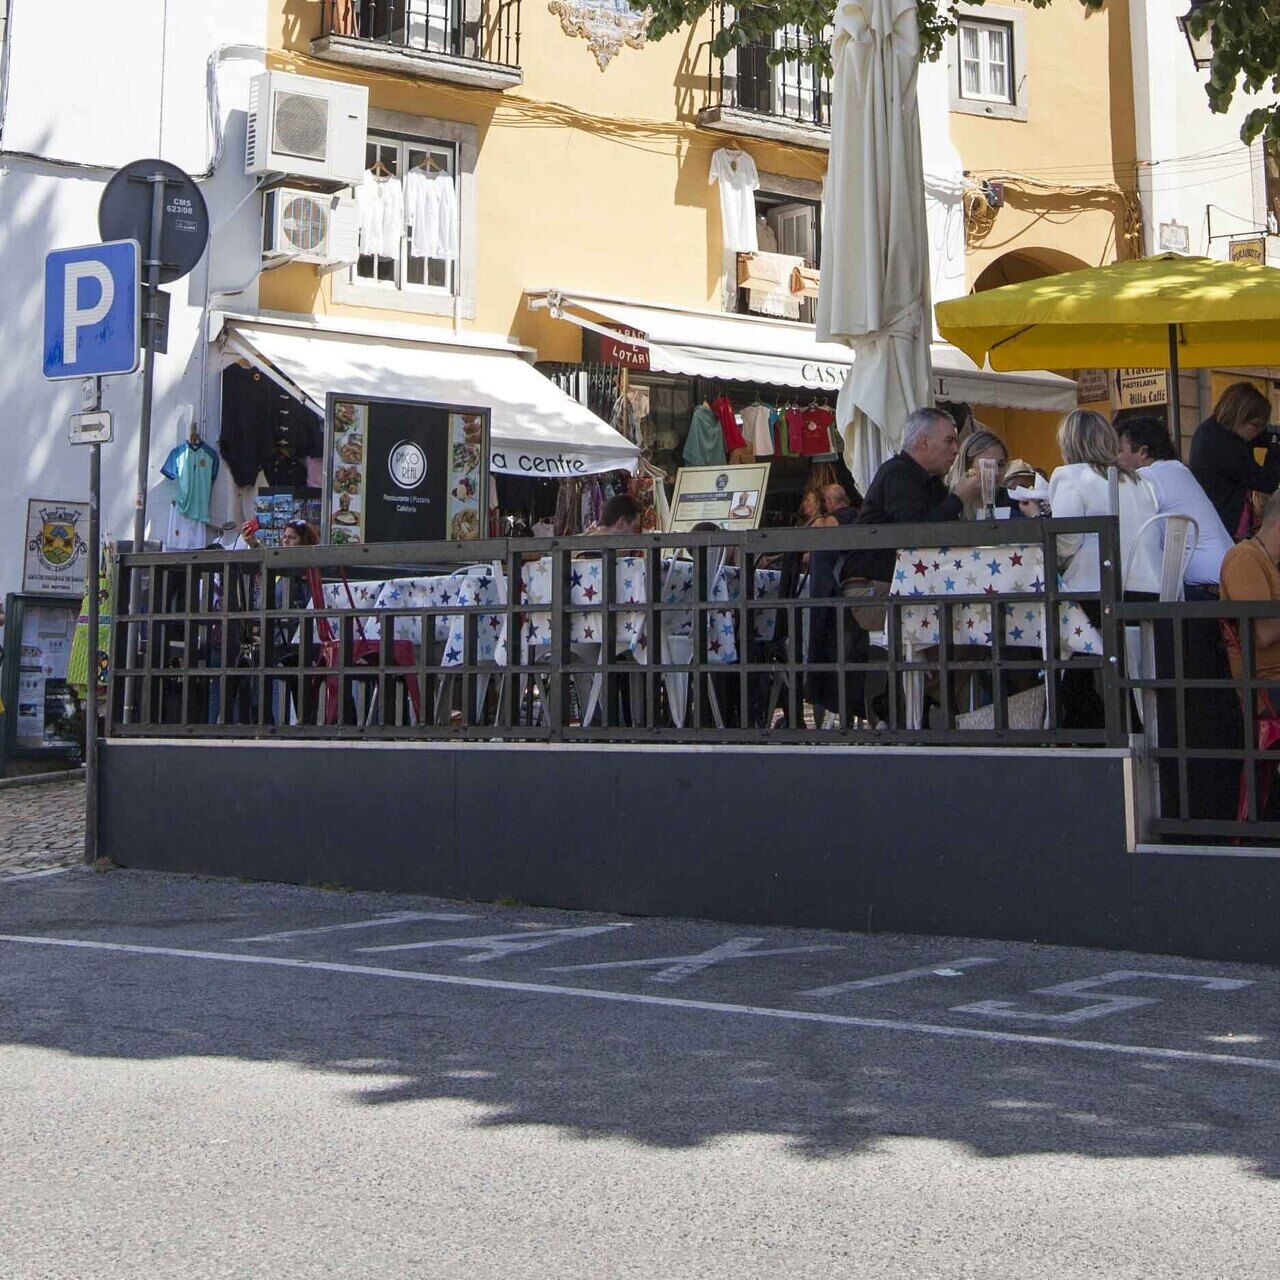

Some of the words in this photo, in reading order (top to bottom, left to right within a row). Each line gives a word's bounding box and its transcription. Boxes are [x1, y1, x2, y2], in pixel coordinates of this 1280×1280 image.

[173, 197, 192, 207] CMS
[63, 260, 115, 365] P
[1122, 379, 1157, 389] PASTELARIA
[518, 453, 588, 474] centre
